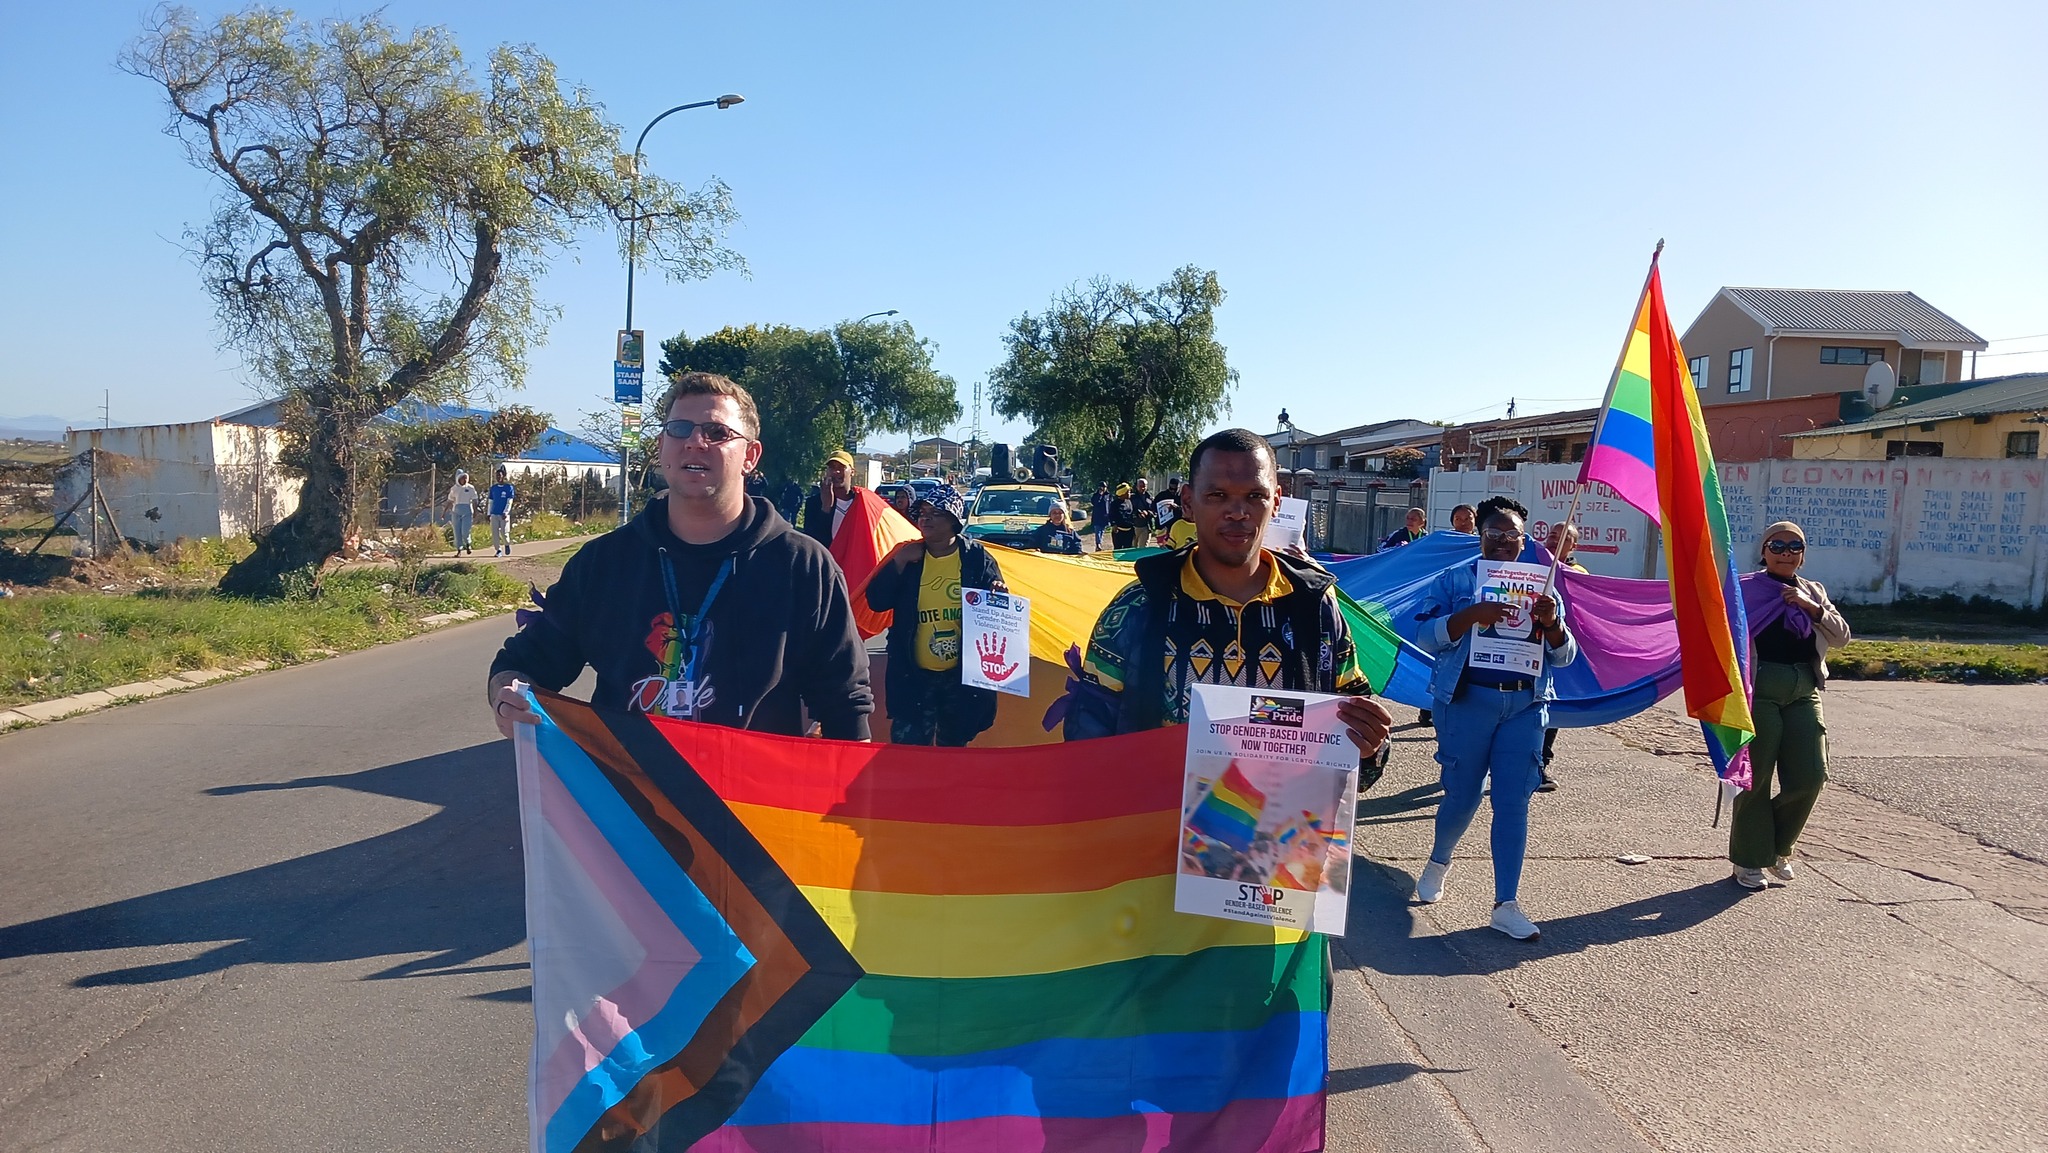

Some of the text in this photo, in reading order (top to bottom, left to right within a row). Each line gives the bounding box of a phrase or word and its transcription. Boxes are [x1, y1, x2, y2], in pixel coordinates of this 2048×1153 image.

[616, 371, 641, 379] STAAN
[617, 378, 640, 386] SAAM
[1719, 466, 1749, 482] EN
[1541, 479, 1623, 501] WINDW GLA
[1721, 486, 1744, 495] HAVE
[1769, 486, 1782, 495] NO
[1786, 487, 1813, 496] OTHER
[1839, 488, 1869, 498] BEFORE
[1873, 488, 1887, 499] ME
[1925, 489, 1952, 500] THOU
[2004, 492, 2027, 502] NOT
[1546, 500, 1564, 510] CUT
[1730, 495, 1753, 504] MAKE
[1808, 497, 1823, 506] ANY
[1827, 498, 1857, 507] GRAVEN
[1860, 499, 1888, 508] IMAGE
[1923, 500, 1951, 510] THU
[1767, 506, 1789, 515] NAME
[1808, 506, 1829, 516] LORD
[1862, 509, 1885, 519] VAIN
[1923, 510, 1950, 520] THOU
[1957, 511, 1990, 522] SHALT
[1801, 517, 1822, 527] KEEP
[1828, 518, 1836, 527] IT
[1842, 519, 1866, 528] HOLY
[1948, 522, 1976, 532] SHALT
[1980, 523, 1996, 532] NOT
[1533, 524, 1548, 539] 59
[1577, 526, 1632, 543] SEN STR.
[1738, 525, 1752, 533] AND
[1823, 527, 1845, 537] THAT
[1945, 532, 1973, 542] SHALT
[1818, 536, 1837, 547] LORD
[1842, 538, 1856, 548] THY
[1862, 538, 1881, 549] GOD
[1905, 541, 2022, 556] ANYTHING THAT IS THY
[1504, 569, 1528, 577] Together
[1529, 572, 1547, 580] Agains
[1500, 581, 1535, 595] NMB
[1485, 592, 1537, 614] PRID
[917, 609, 940, 623] OTE
[991, 609, 1000, 617] Up
[1000, 612, 1022, 621] Against
[974, 619, 1000, 630] Violence
[945, 650, 958, 661] AN
[982, 661, 1007, 675] STOP
[628, 674, 715, 711] Prde
[1272, 711, 1303, 723] Pride
[1209, 723, 1342, 746] STOP GENDER-BASED VIOLENCE
[1241, 739, 1306, 755] NOW TOGETHER
[1234, 752, 1273, 760] SOLIDARITY
[1291, 757, 1323, 765] LGBTQIA+
[1224, 899, 1293, 915] GENDER-BASED VIOLENCE
[1223, 908, 1296, 923] #StandAgainstViolence
